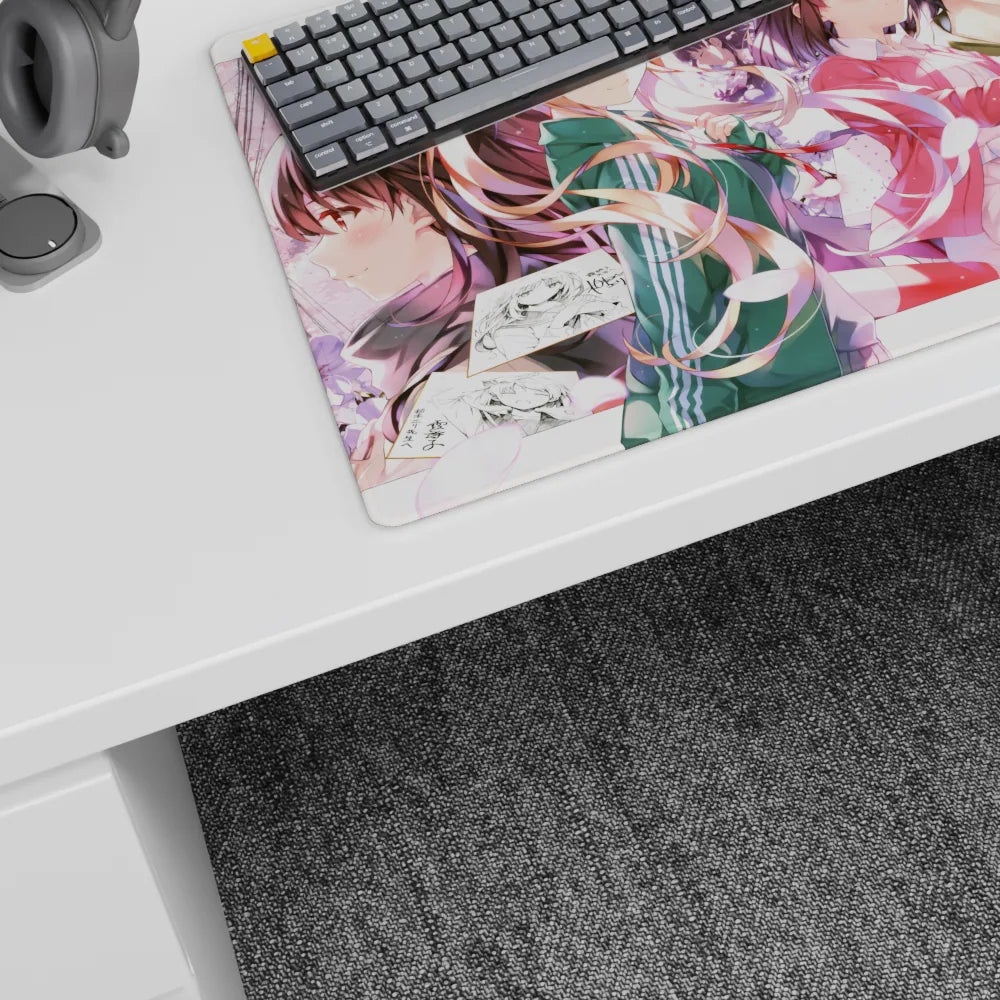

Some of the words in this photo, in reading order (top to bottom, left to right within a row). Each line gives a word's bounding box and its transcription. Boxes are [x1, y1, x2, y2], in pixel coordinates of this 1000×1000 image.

[676, 5, 696, 16] control
[284, 79, 295, 87] tab
[320, 119, 334, 129] shift
[390, 113, 418, 129] command
[355, 131, 374, 143] option
[314, 147, 335, 159] control
